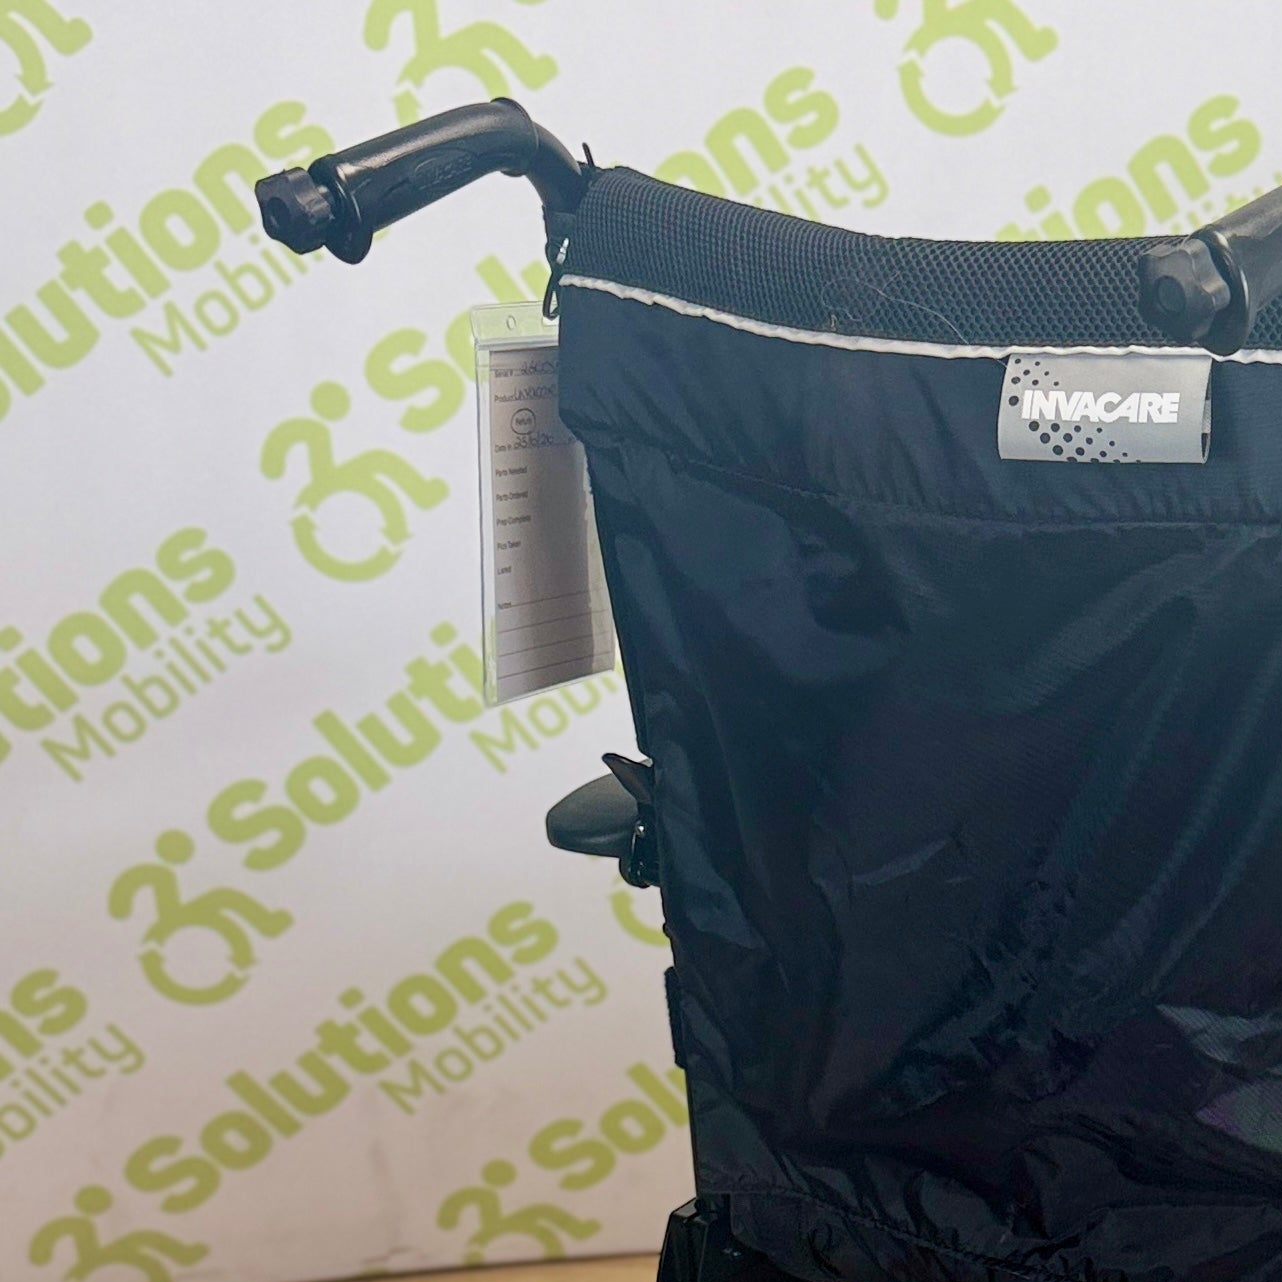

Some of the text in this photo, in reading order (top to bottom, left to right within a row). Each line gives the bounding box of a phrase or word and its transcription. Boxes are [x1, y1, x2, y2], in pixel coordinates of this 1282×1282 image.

[1021, 390, 1181, 424] INVACARE
[0, 527, 236, 764] tions
[40, 594, 292, 783] Mobility
[207, 621, 487, 872] Soluti
[123, 901, 559, 1214] Solutions
[378, 957, 608, 1116] Mobility
